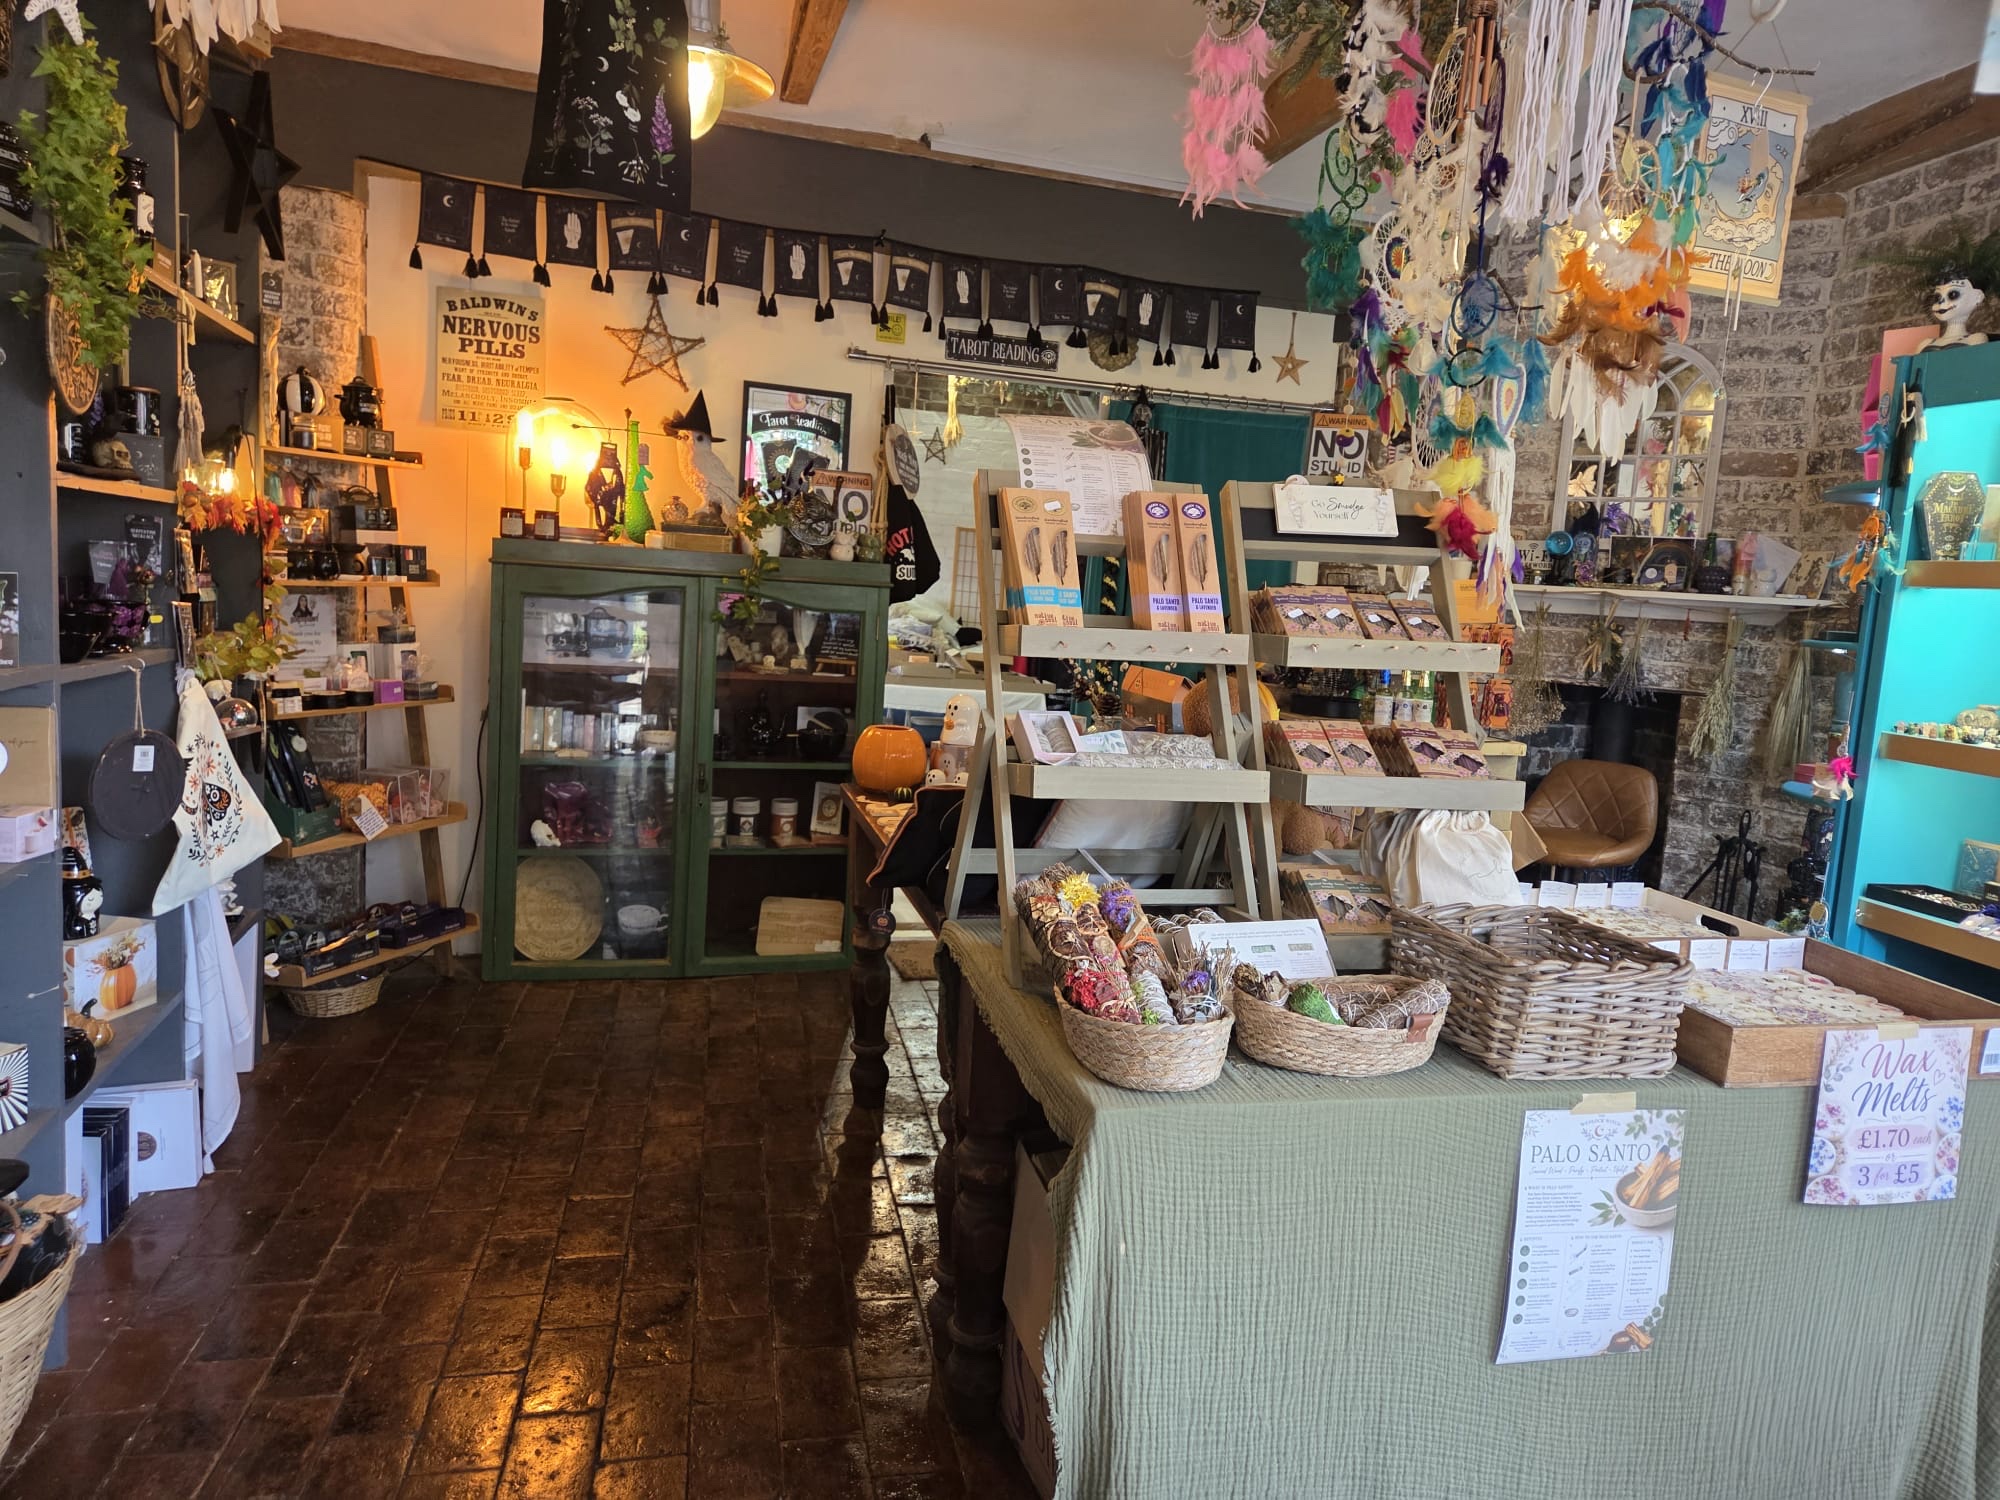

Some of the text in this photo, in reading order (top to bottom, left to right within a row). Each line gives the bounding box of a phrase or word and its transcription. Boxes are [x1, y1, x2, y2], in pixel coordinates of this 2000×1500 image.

[1708, 252, 1731, 271] THE
[442, 314, 541, 345] NERVOUS
[458, 336, 526, 359] PILLS
[951, 337, 1040, 363] TAROT READING
[759, 412, 789, 428] Tarot
[1328, 416, 1368, 427] WARNING
[1312, 429, 1365, 460] NO
[1310, 459, 1361, 474] STUID
[828, 476, 870, 487] WRNING
[1312, 509, 1351, 520] Yourself
[1326, 497, 1366, 519] Smudge
[1152, 597, 1180, 605] PALO SANTO
[1204, 597, 1219, 605] SANTO
[1861, 1039, 1937, 1080] Wax
[1851, 1077, 1937, 1117] Melts
[1858, 1128, 1933, 1150] £1.70 each
[1530, 1143, 1651, 1164] PALO SANTO
[1857, 1164, 1920, 1186] 3 for £5
